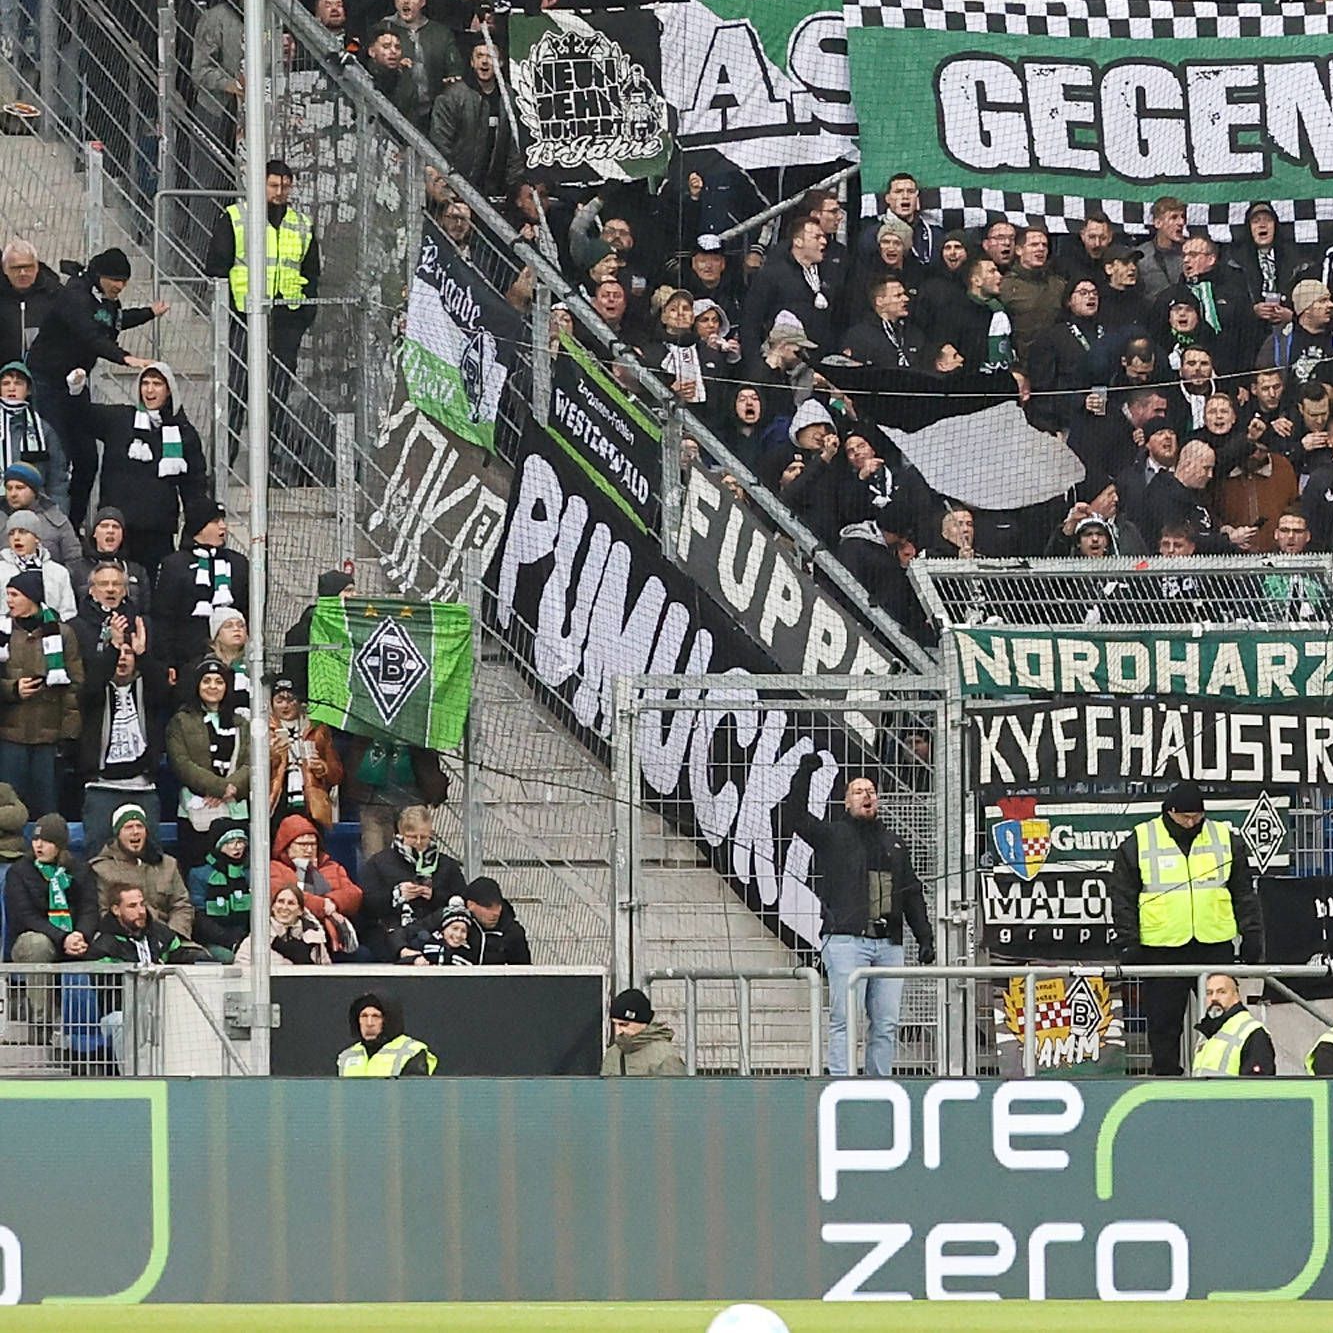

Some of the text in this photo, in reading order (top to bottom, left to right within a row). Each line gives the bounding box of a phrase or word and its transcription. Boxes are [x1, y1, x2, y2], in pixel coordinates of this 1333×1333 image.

[554, 387, 650, 506] WESTERWALD
[818, 1078, 1085, 1201] pre
[820, 1220, 1190, 1301] zero
